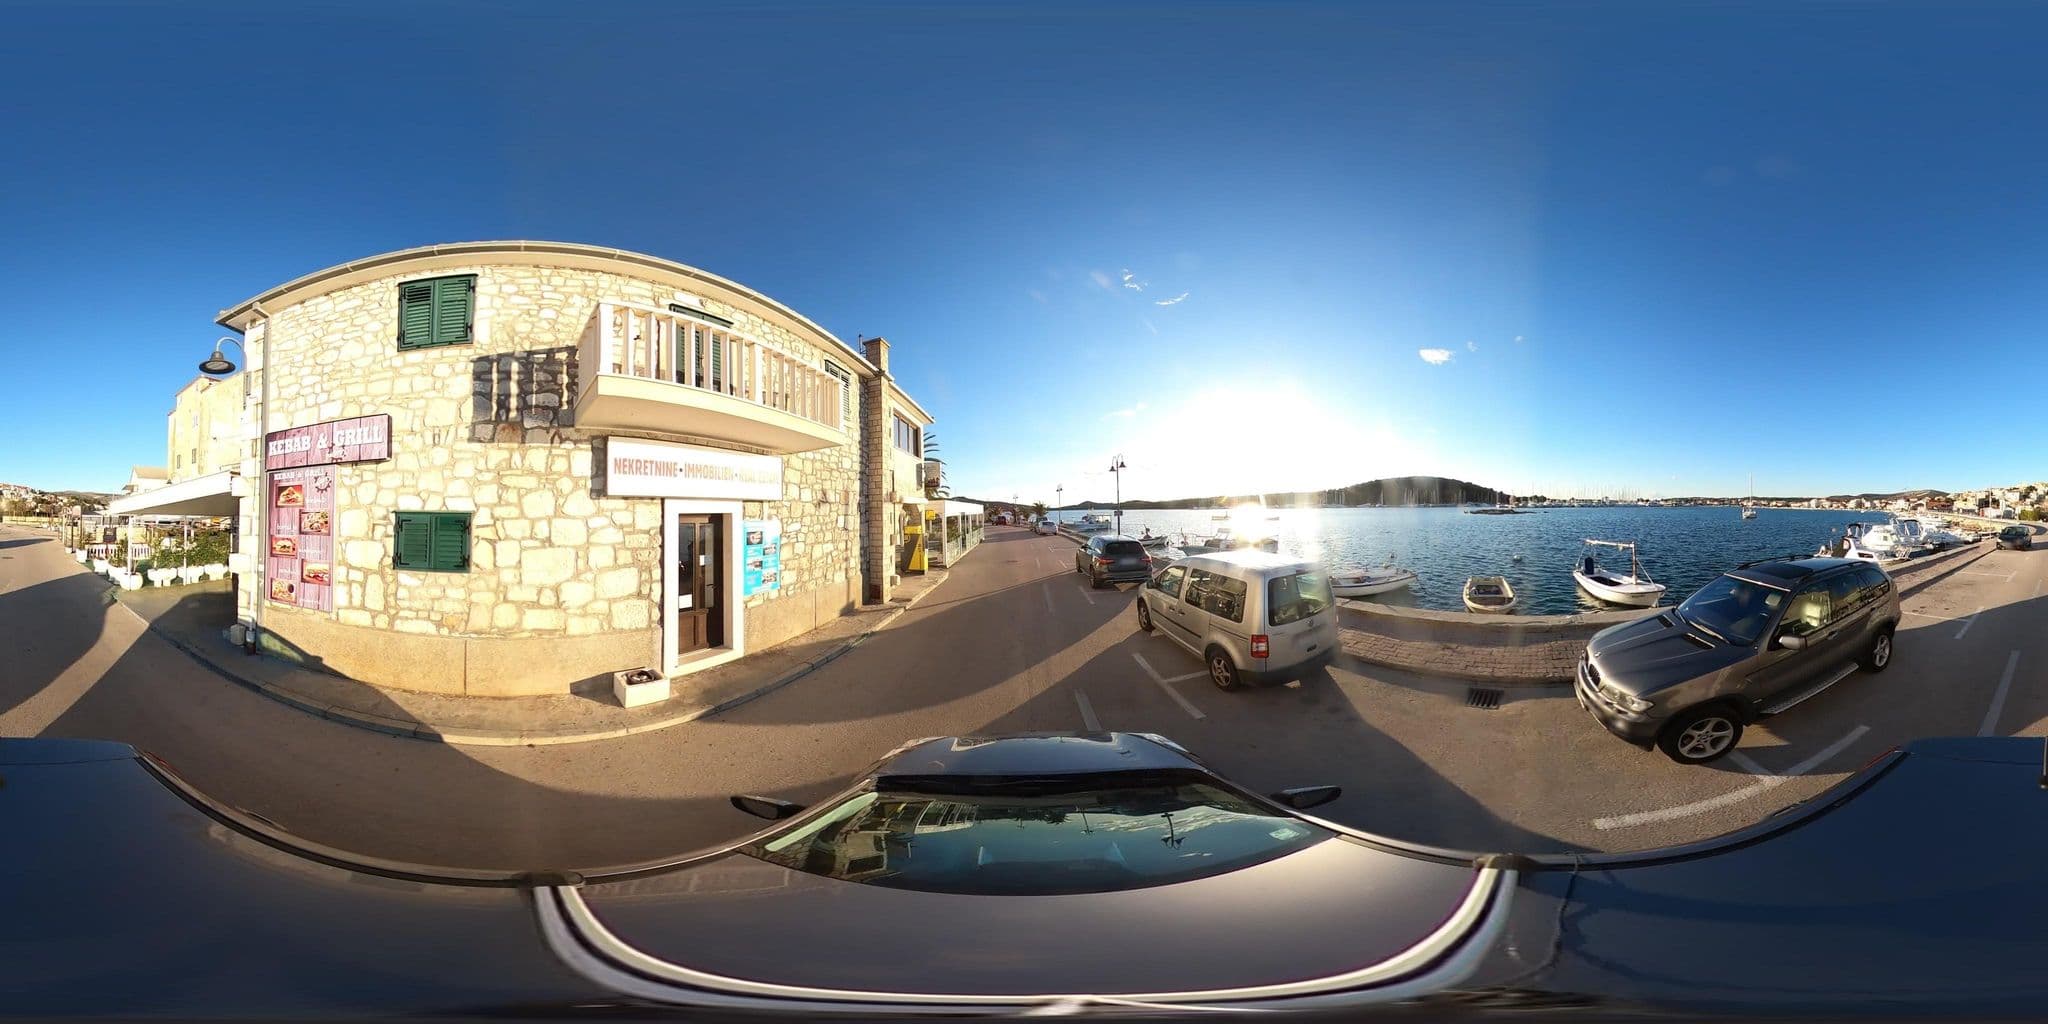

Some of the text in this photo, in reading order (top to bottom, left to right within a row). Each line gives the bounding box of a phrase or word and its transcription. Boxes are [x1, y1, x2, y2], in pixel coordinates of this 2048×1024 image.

[269, 436, 311, 456] KEBAB
[317, 434, 328, 449] &
[336, 426, 383, 446] GRILL
[614, 457, 678, 477] NEKRETNINE
[684, 463, 734, 481] IMMOBILIEN
